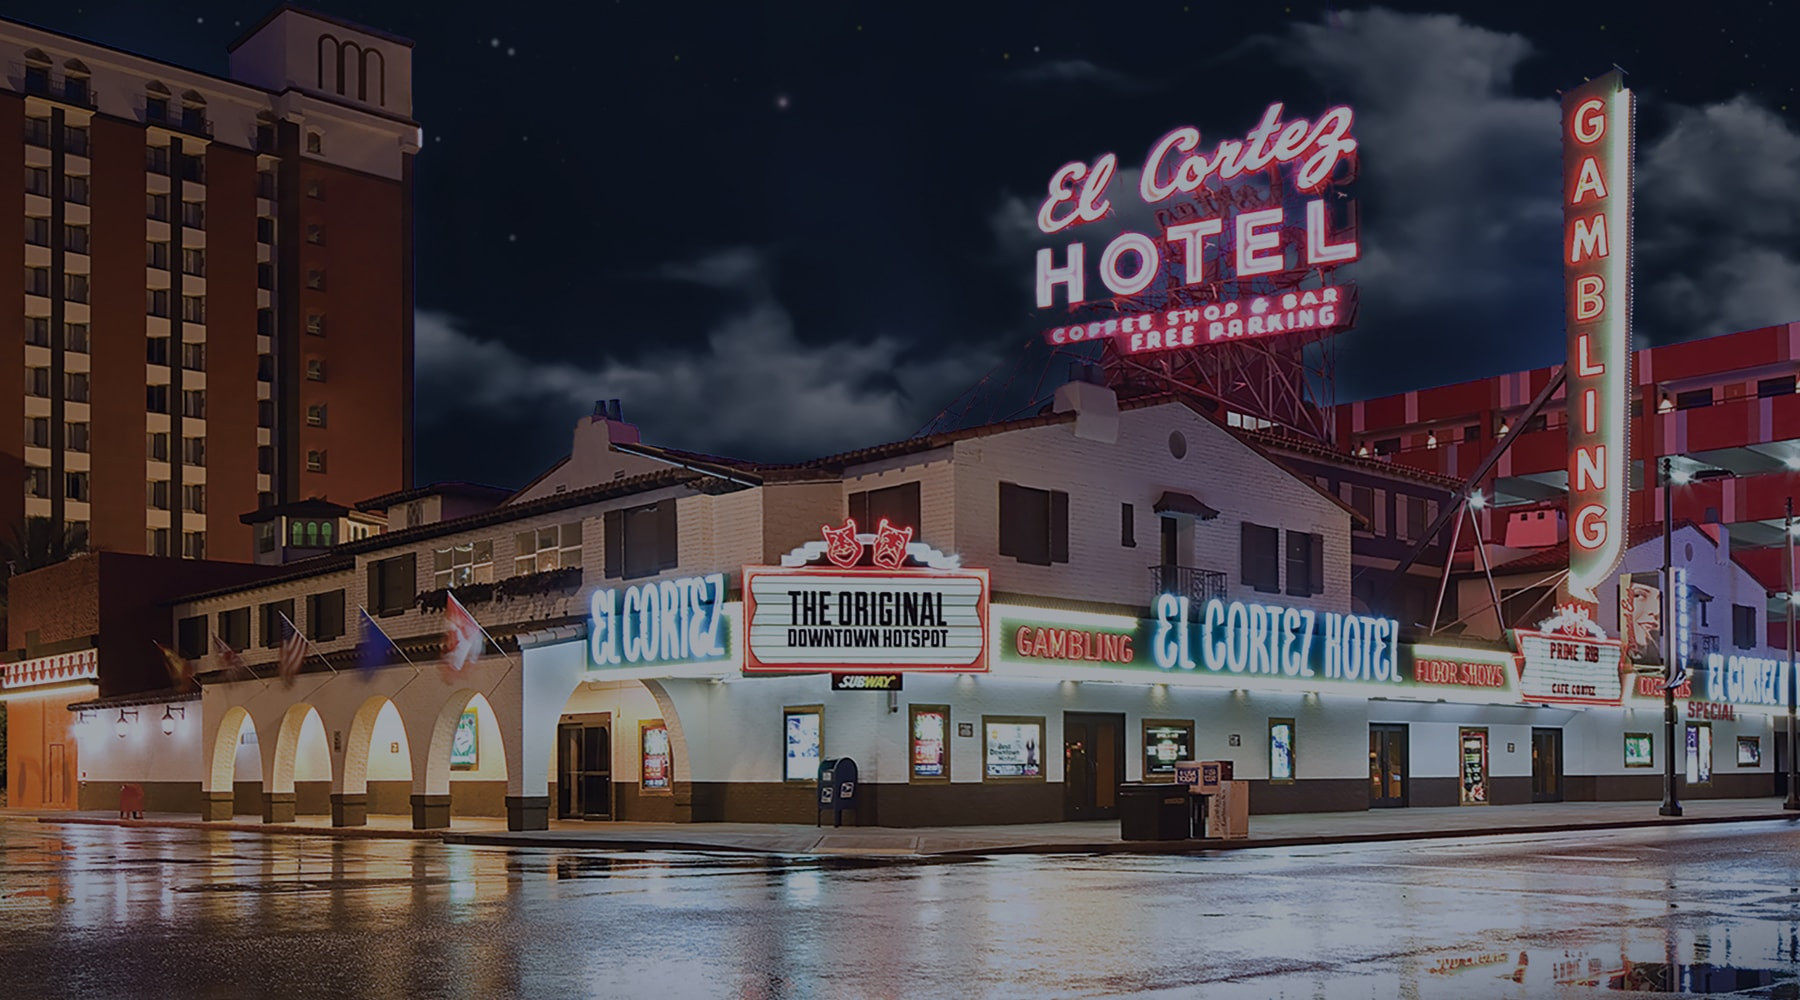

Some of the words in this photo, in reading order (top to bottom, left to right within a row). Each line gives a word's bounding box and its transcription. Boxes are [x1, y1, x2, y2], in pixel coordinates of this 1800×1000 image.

[1037, 153, 1116, 233] El
[1140, 102, 1357, 202] Cortez
[1036, 199, 1357, 309] HOTEL
[1052, 313, 1153, 343] COFFEE
[1166, 302, 1239, 326] SHOP
[1250, 297, 1269, 313] &
[1282, 286, 1338, 310] BAR
[1131, 325, 1194, 352] FREE
[1209, 305, 1336, 341] PARKING
[1571, 97, 1609, 549] GAMBLING
[591, 588, 623, 665] EL
[622, 573, 726, 663] CORTEZ
[788, 590, 830, 626] THE
[838, 591, 948, 626] ORIGINAL
[788, 629, 880, 648] DOWNTOWN
[882, 629, 949, 648] HOTSPOT
[1015, 625, 1134, 664] GAMBLING
[1155, 593, 1196, 670] EL
[1203, 598, 1315, 677] CORTEZ
[1325, 612, 1404, 683] HOTEL
[1550, 642, 1579, 662] PRIME
[1584, 646, 1600, 663] RIB
[838, 675, 896, 688] SUBWAY
[1415, 659, 1458, 685] FLOOR
[1460, 663, 1505, 688] SHOWS
[1551, 683, 1570, 695] CAFE
[1571, 685, 1597, 696] CORTEZ
[1638, 677, 1692, 699] COCKILS
[1687, 701, 1736, 721] SPECIAL
